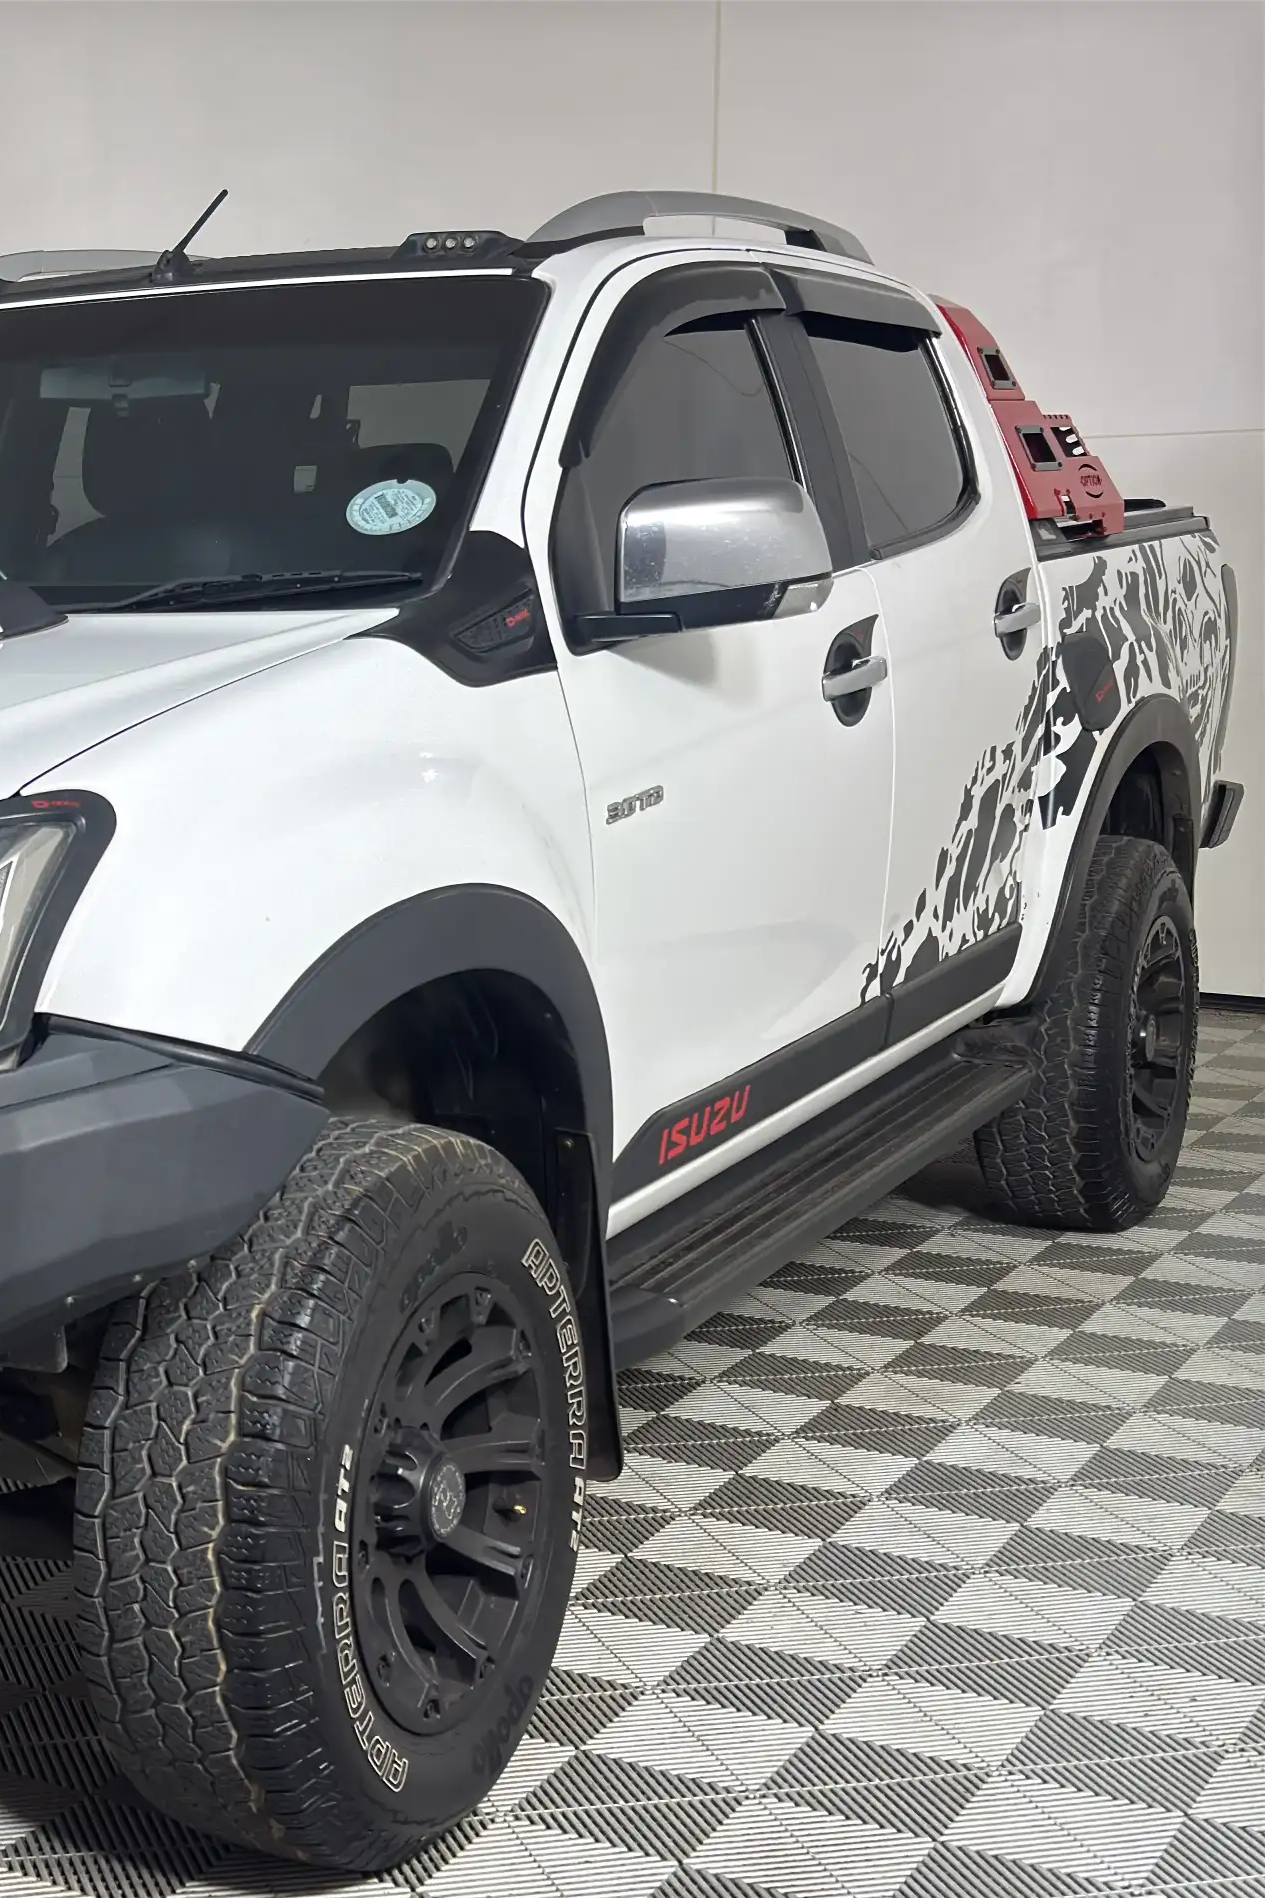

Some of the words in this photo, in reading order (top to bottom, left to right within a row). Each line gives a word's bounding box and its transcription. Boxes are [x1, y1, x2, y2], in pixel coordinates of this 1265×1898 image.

[659, 1084, 752, 1166] ISUZU
[521, 1238, 586, 1470] APTERRA
[333, 1540, 409, 1793] APTERRA
